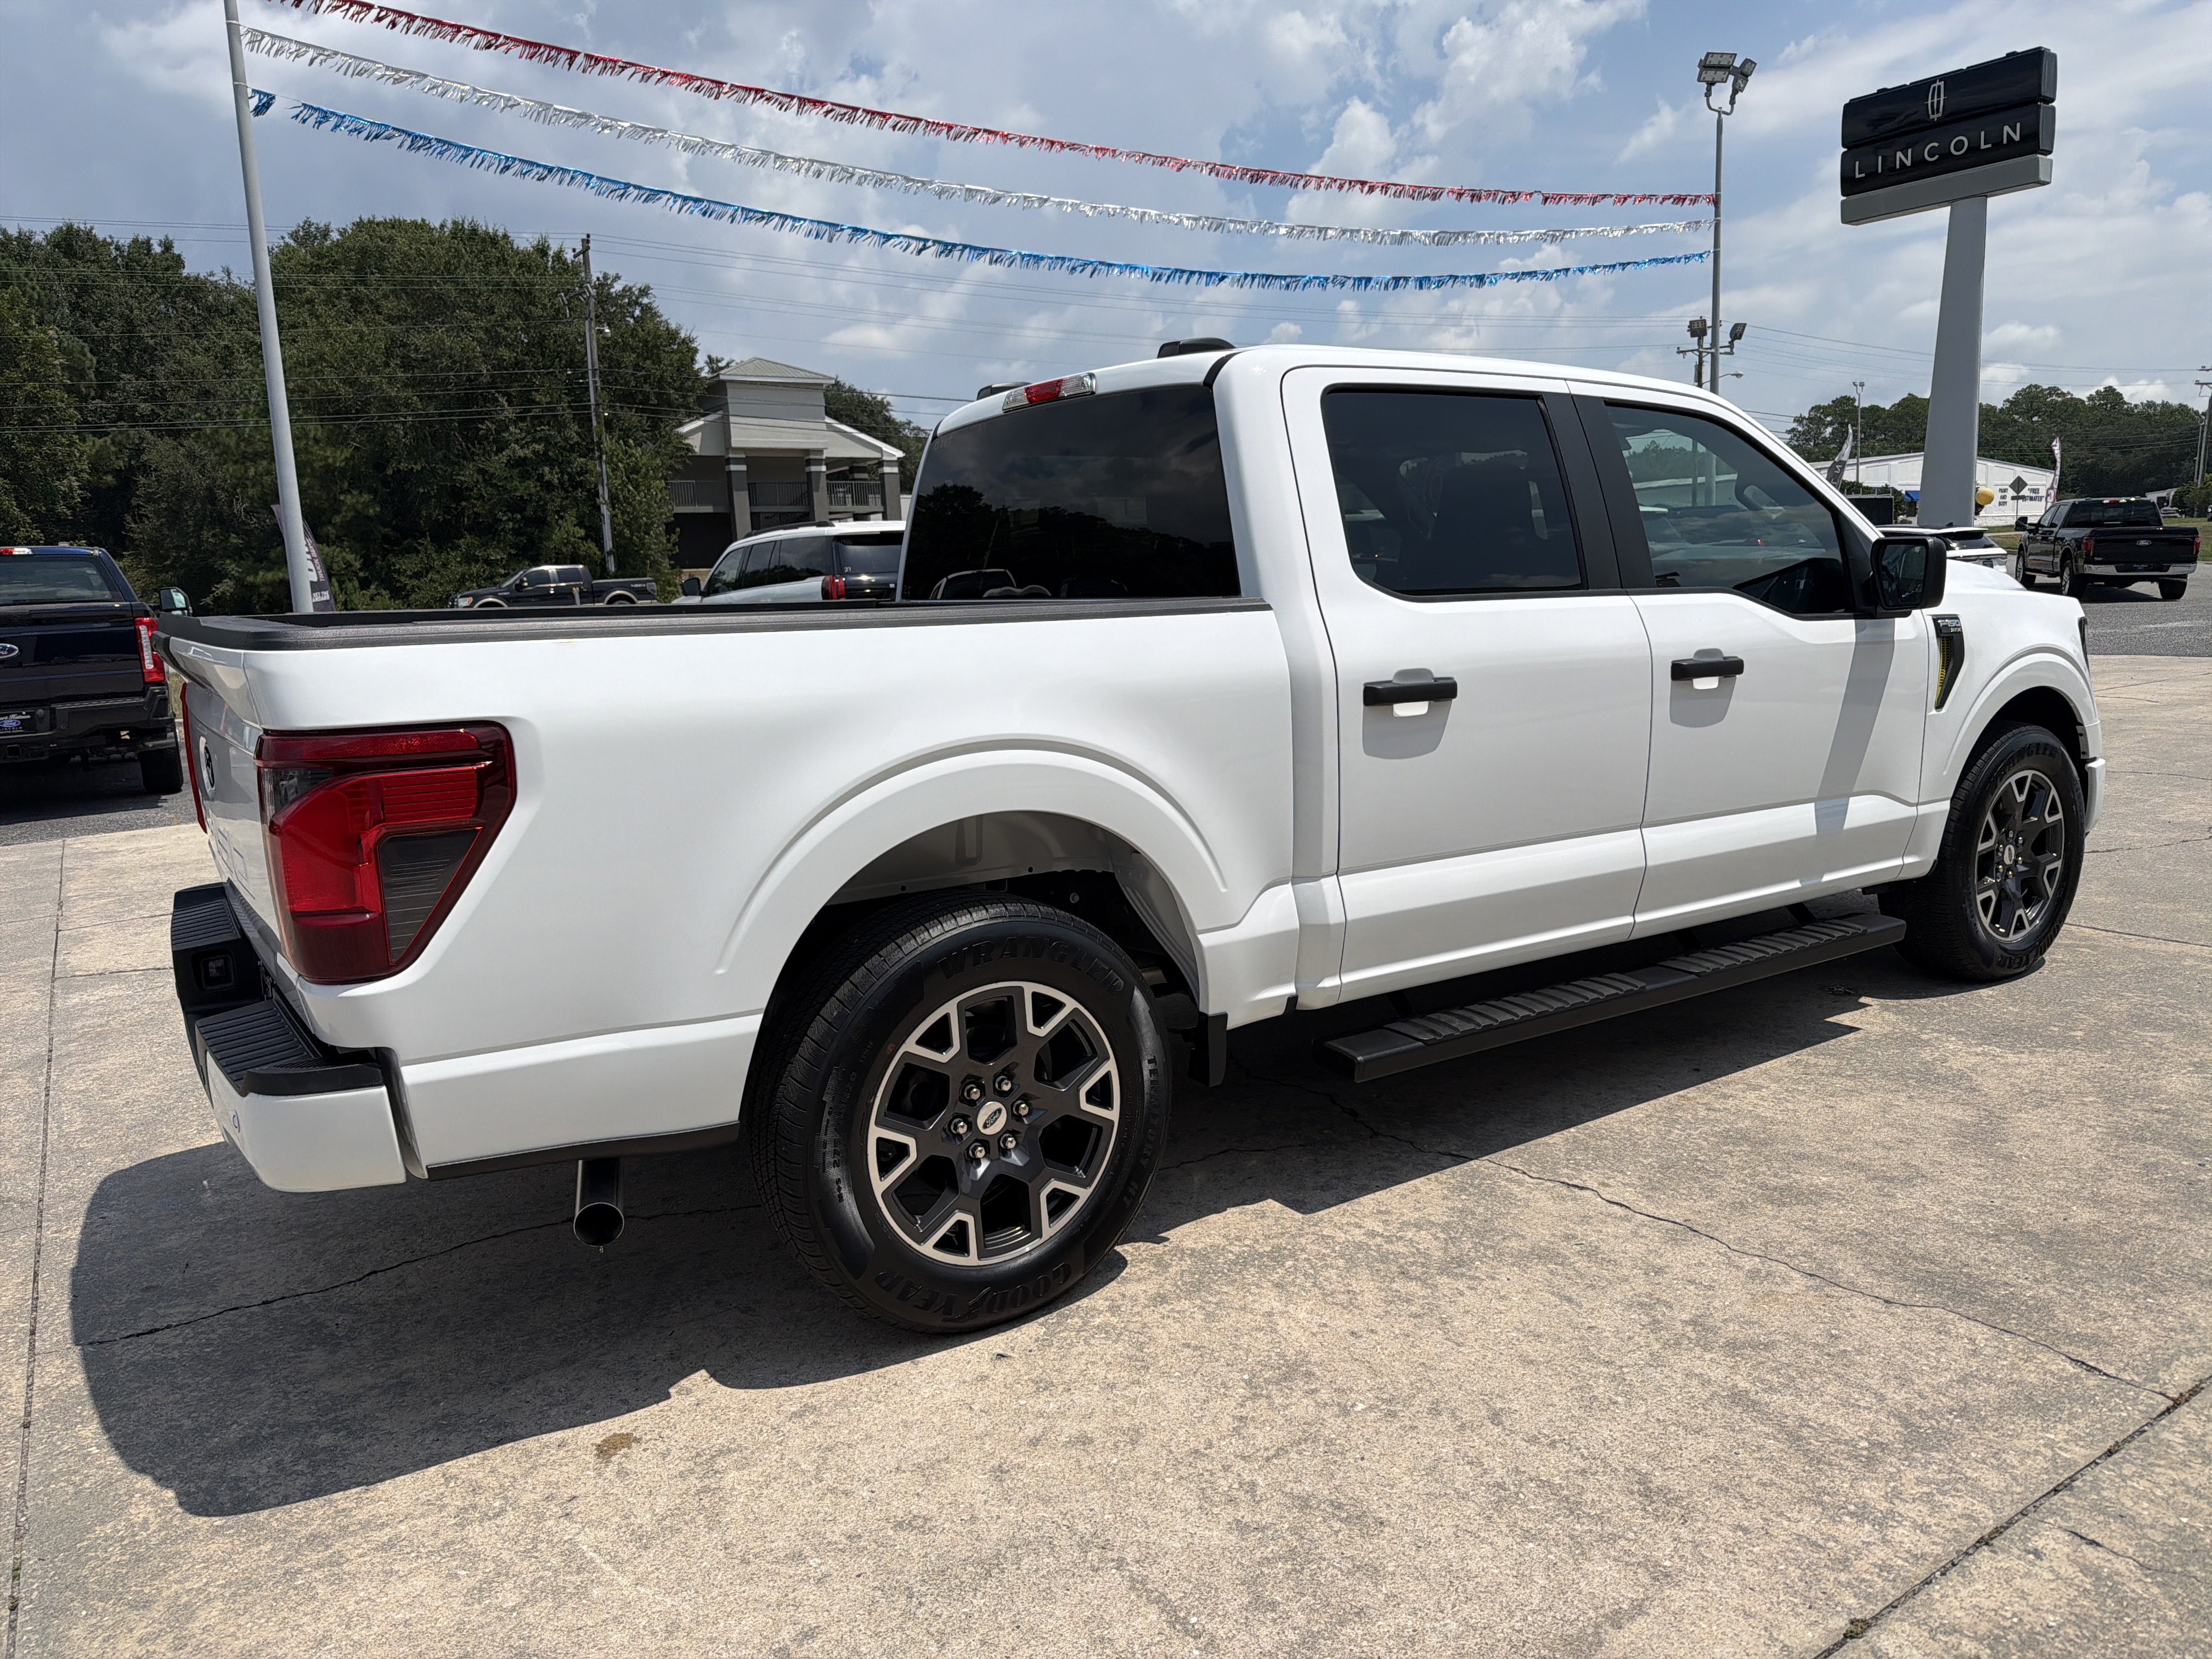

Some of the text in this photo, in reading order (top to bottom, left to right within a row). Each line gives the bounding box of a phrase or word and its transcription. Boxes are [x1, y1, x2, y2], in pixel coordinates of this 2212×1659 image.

[1855, 122, 2021, 179] LINCOLN
[935, 936, 1125, 994] WRANGLER
[986, 1111, 1000, 1127] Ford
[874, 1262, 1072, 1323] GOODYEAR
